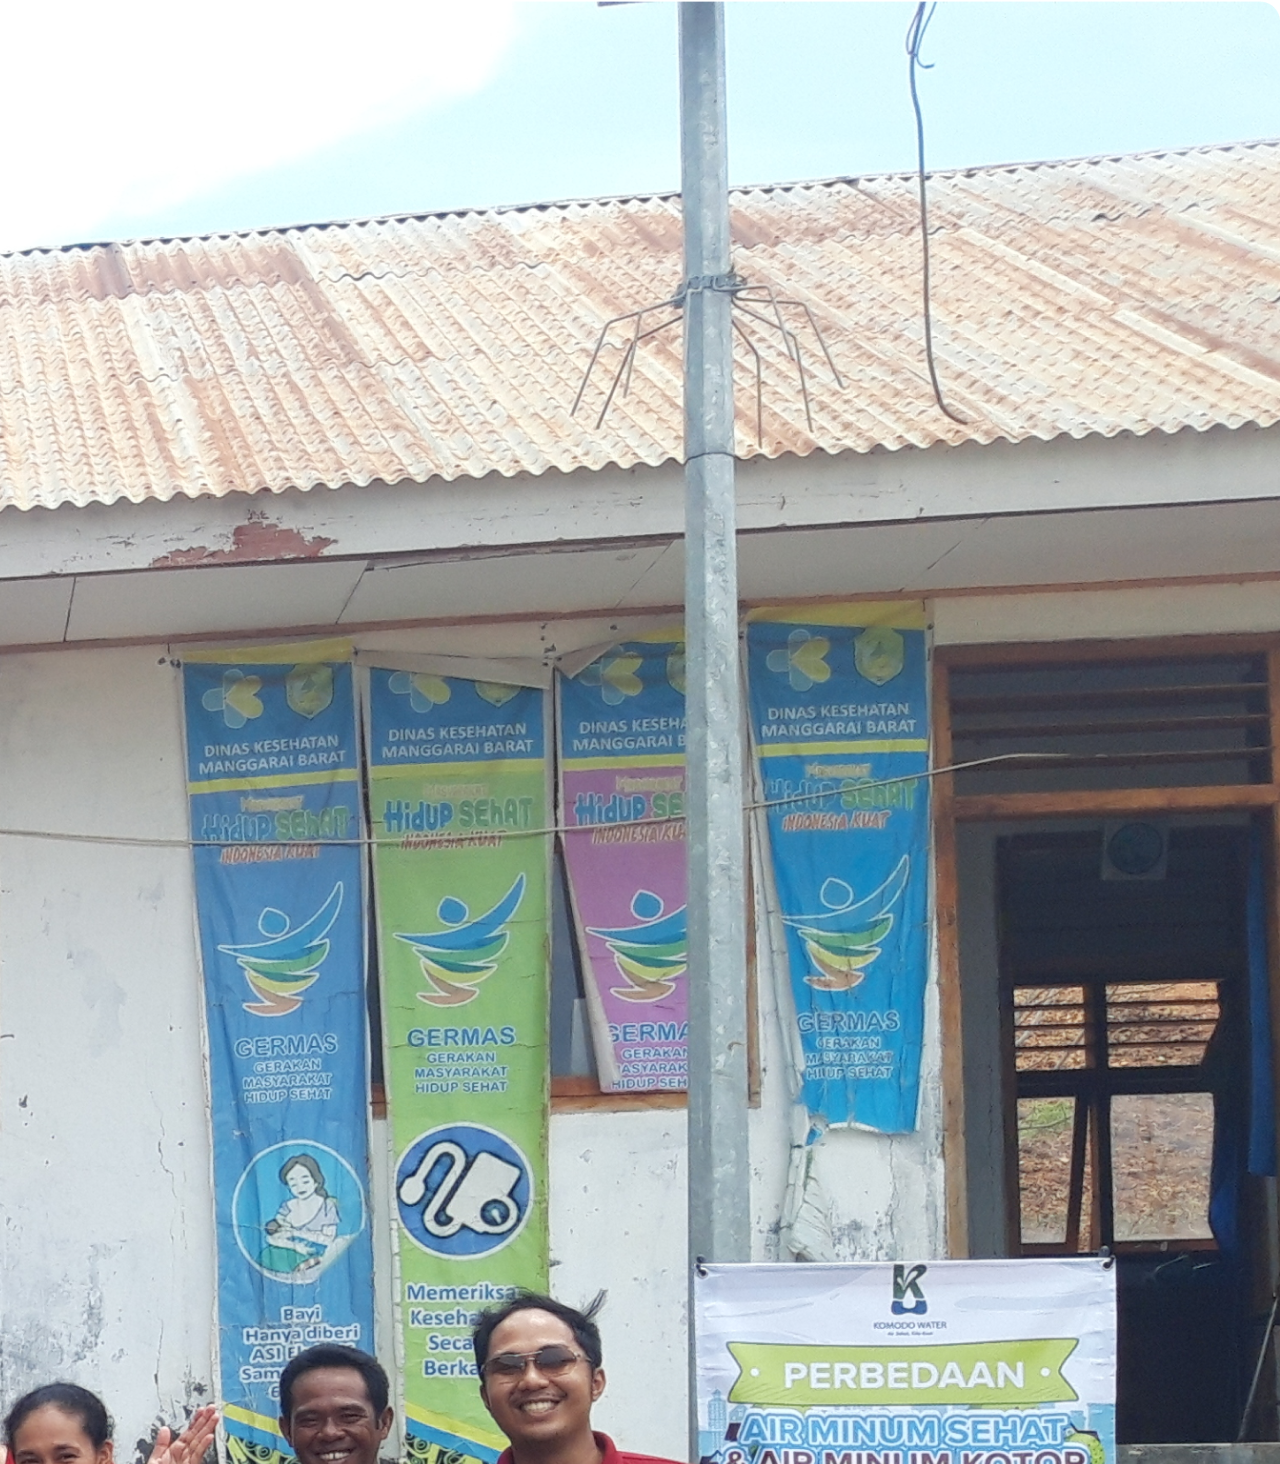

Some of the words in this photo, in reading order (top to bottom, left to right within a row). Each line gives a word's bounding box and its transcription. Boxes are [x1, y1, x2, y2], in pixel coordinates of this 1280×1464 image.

[768, 706, 816, 720] DINAS
[821, 703, 909, 718] KESEHATAN
[389, 727, 435, 741] DINAS
[440, 723, 527, 739] KESEHATAN
[580, 720, 627, 734] DINAS
[762, 721, 861, 738] MANGGARAI
[867, 719, 916, 734] BARAT
[204, 743, 250, 757] DINAS
[254, 735, 339, 753] KESEHATAN
[382, 742, 479, 758] MANGGARAI
[484, 739, 533, 753] BARAT
[573, 735, 672, 751] MANGGARAI
[199, 757, 294, 775] MANGGARAI
[298, 750, 346, 766] BARAT
[797, 1010, 899, 1033] GERMAS
[407, 1027, 516, 1048] GERMAS
[608, 1023, 688, 1042] GERMA
[235, 1034, 338, 1058] GERMAS
[427, 1052, 495, 1063] GERAKAN
[255, 1059, 321, 1073] GERAKAN
[415, 1066, 507, 1078] MASYARAKAT
[620, 1062, 688, 1075] ASYARAK
[848, 1066, 893, 1078] SEHAT
[243, 1073, 332, 1088] MASYARAKAT
[415, 1082, 458, 1093] HIDUP
[462, 1081, 507, 1092] SEHAT
[612, 1078, 655, 1089] HIDUP
[660, 1078, 687, 1088] SEH
[245, 1090, 287, 1103] HIDUP
[290, 1088, 332, 1100] SEHAT
[407, 1284, 516, 1300] Memeriksa
[283, 1307, 320, 1322] Bayi
[873, 1322, 915, 1330] KOMODO
[917, 1321, 947, 1330] WATER
[244, 1330, 301, 1344] Hanya
[306, 1325, 358, 1340] diberi
[428, 1335, 473, 1351] Seca
[251, 1347, 281, 1361] ASI
[241, 1367, 281, 1381] Sam
[424, 1359, 479, 1376] Berka
[784, 1361, 1024, 1389] PERBEDAAN
[743, 1417, 803, 1444] AIR
[809, 1418, 936, 1445] MINUM
[945, 1416, 1067, 1444] SEHAT
